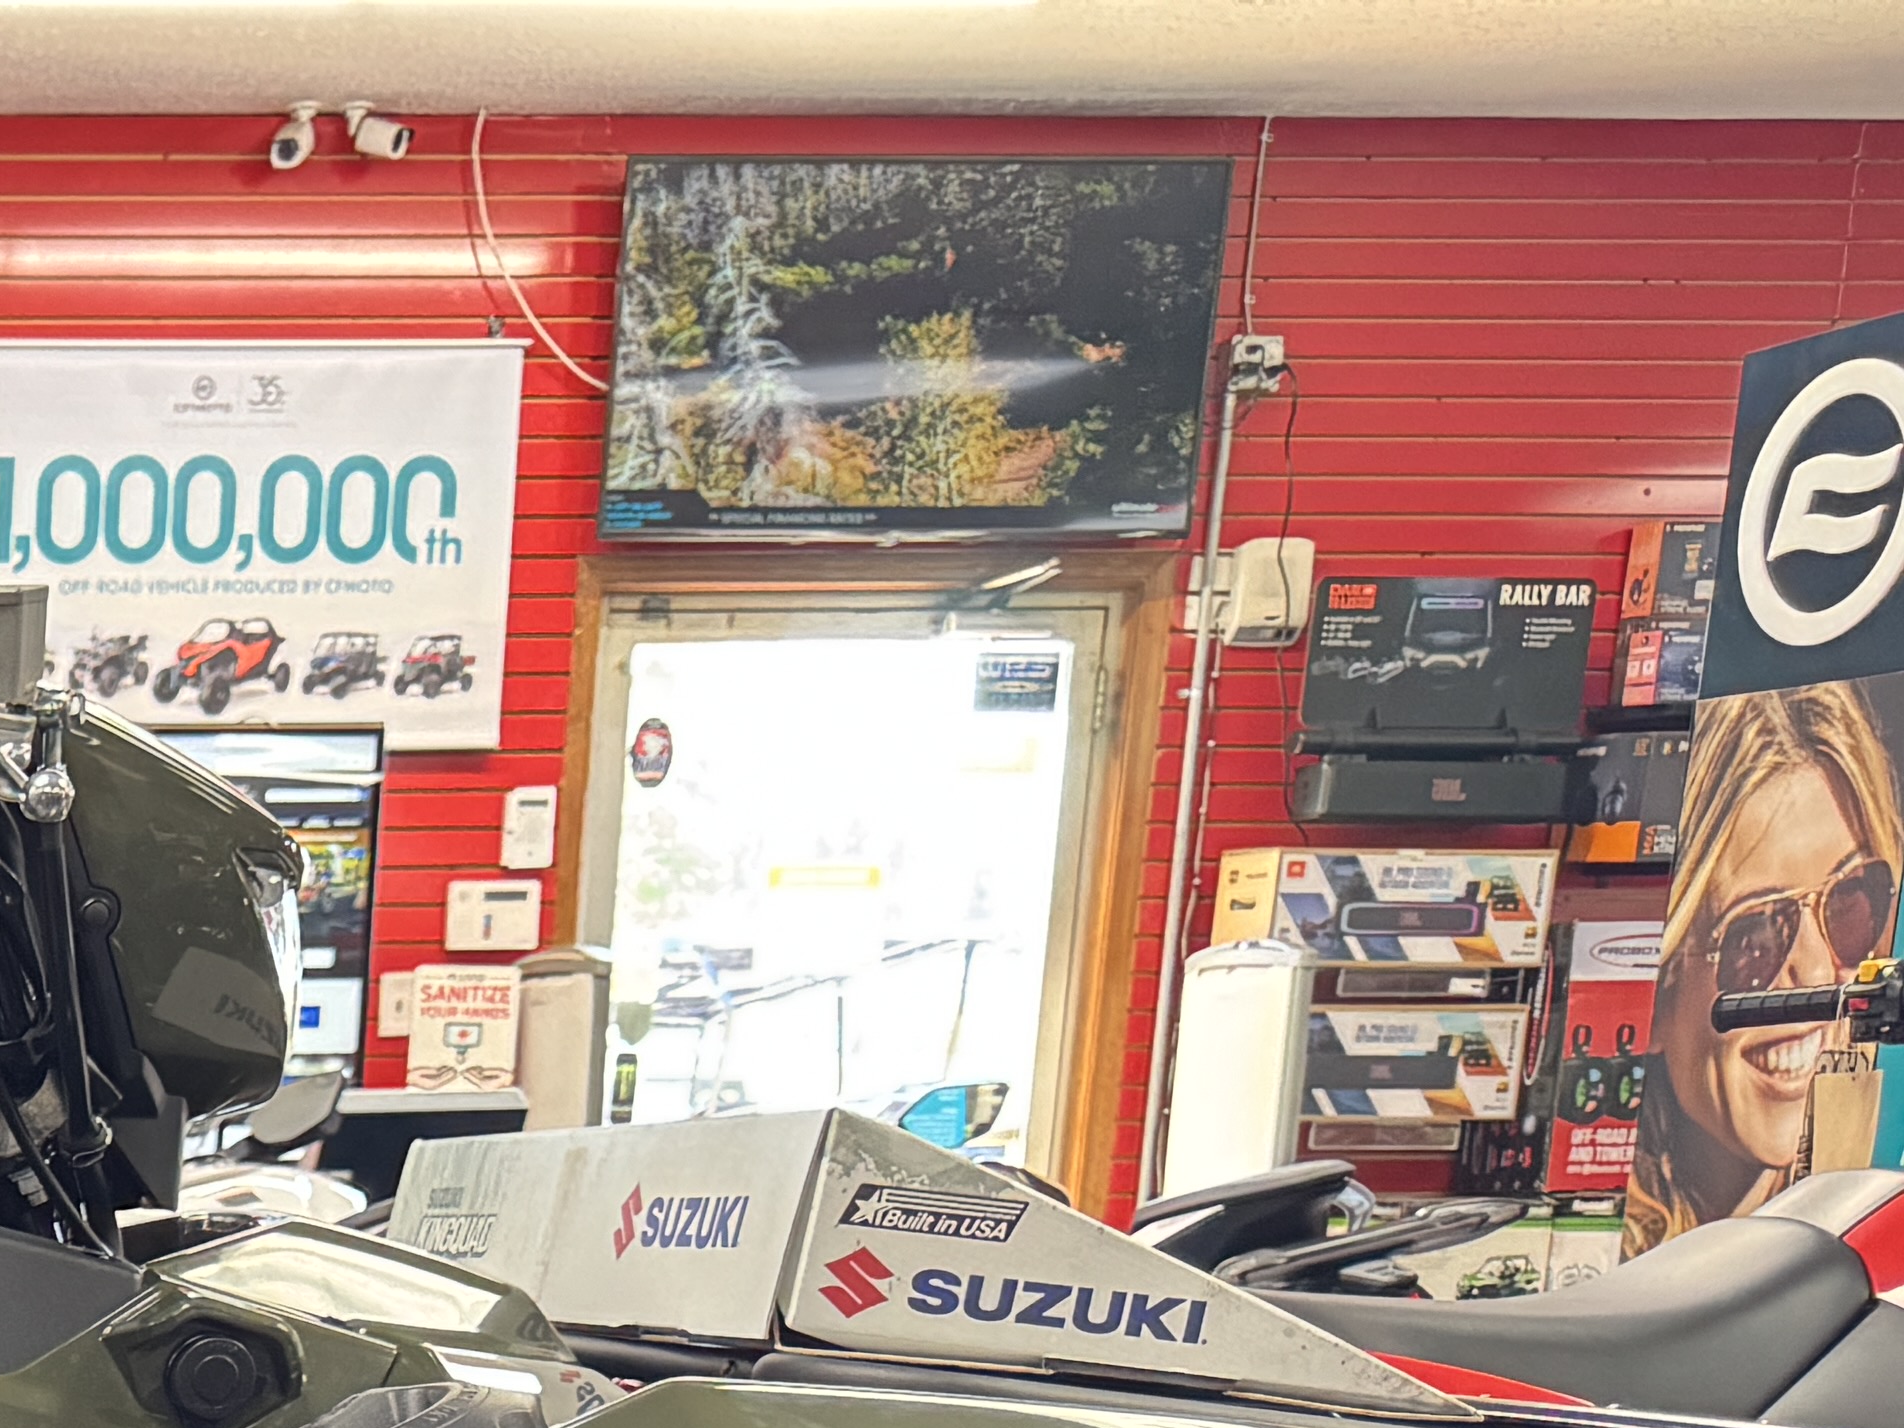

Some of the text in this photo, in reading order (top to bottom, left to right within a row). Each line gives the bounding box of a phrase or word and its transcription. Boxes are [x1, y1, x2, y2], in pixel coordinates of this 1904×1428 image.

[425, 529, 462, 564] th
[1498, 584, 1592, 606] RALLY BAR
[415, 1214, 498, 1259] KINGQUAD
[640, 1195, 749, 1249] SUZUKI
[882, 1206, 1009, 1240] Built in USA
[907, 1269, 1206, 1345] SUZUKI
